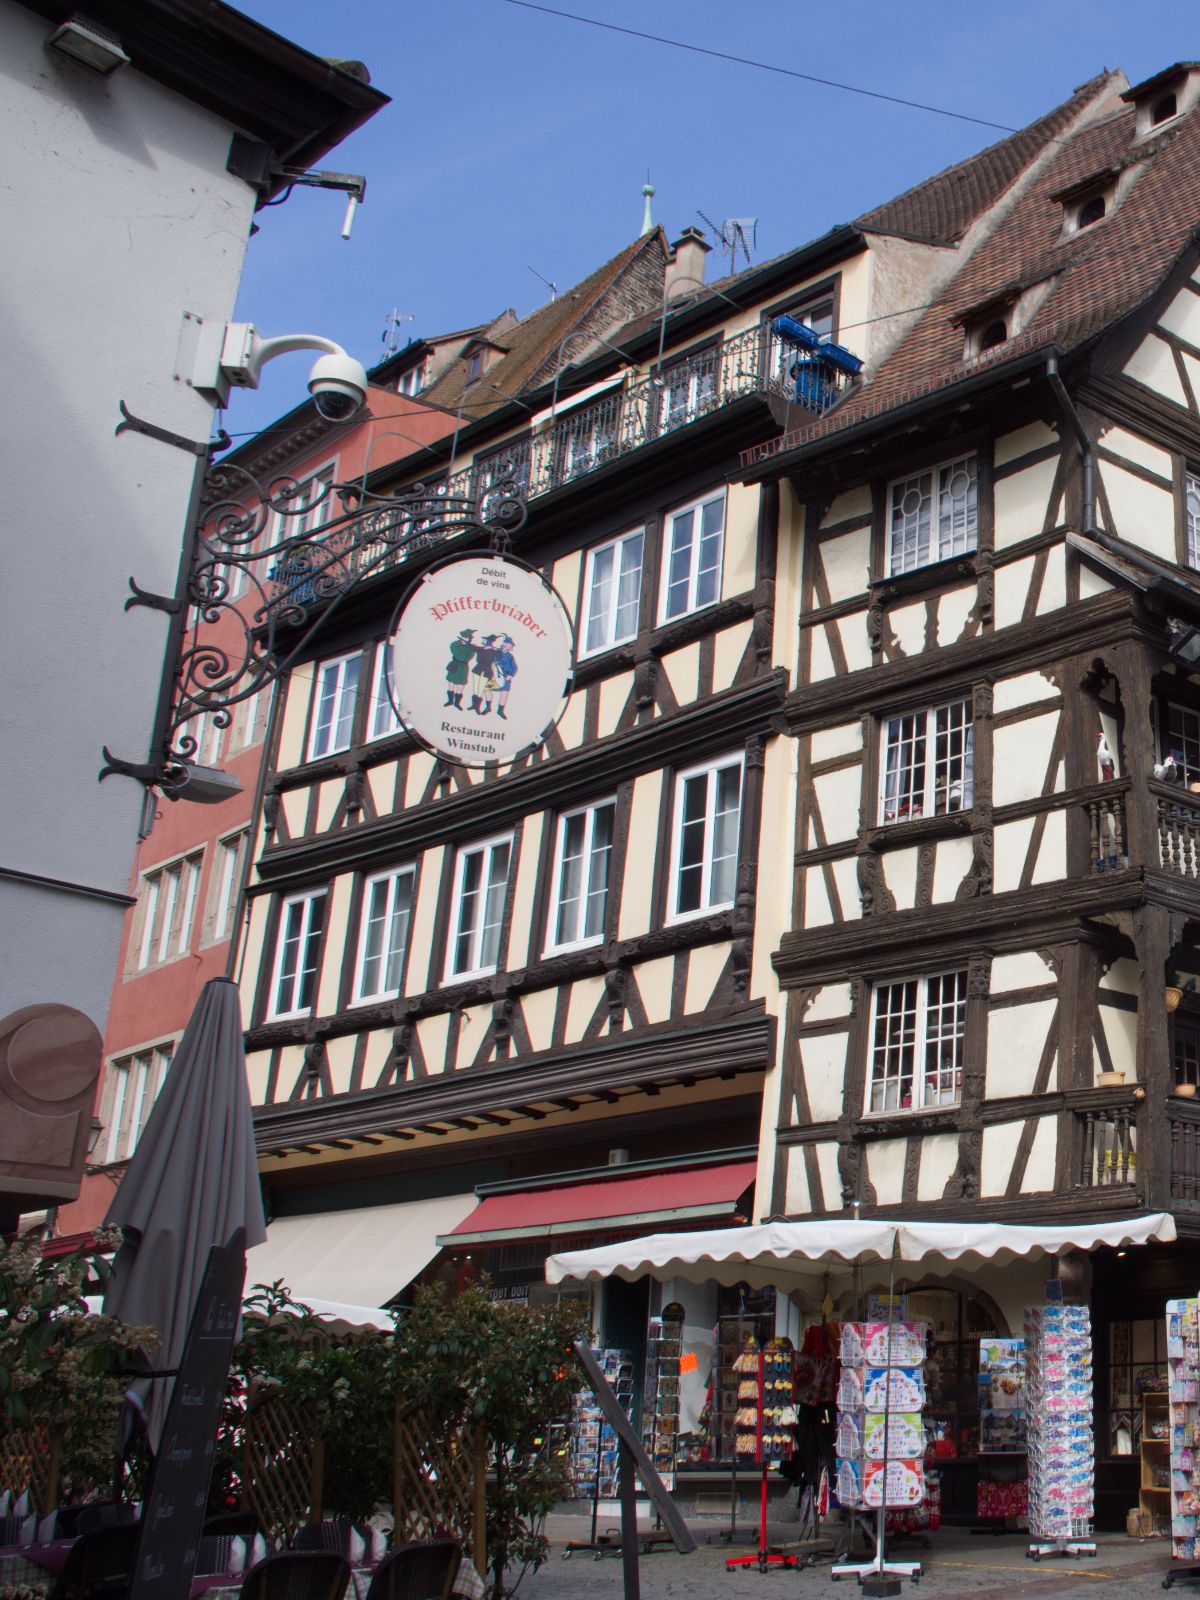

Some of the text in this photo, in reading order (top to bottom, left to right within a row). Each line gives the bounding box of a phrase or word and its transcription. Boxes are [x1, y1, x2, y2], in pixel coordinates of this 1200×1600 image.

[481, 567, 506, 579] Débit
[476, 578, 511, 590] de vins
[428, 596, 548, 640] Pfifferbriader
[440, 721, 506, 741] Restaurant
[446, 737, 496, 755] Winstub
[511, 1286, 529, 1297] DOIT
